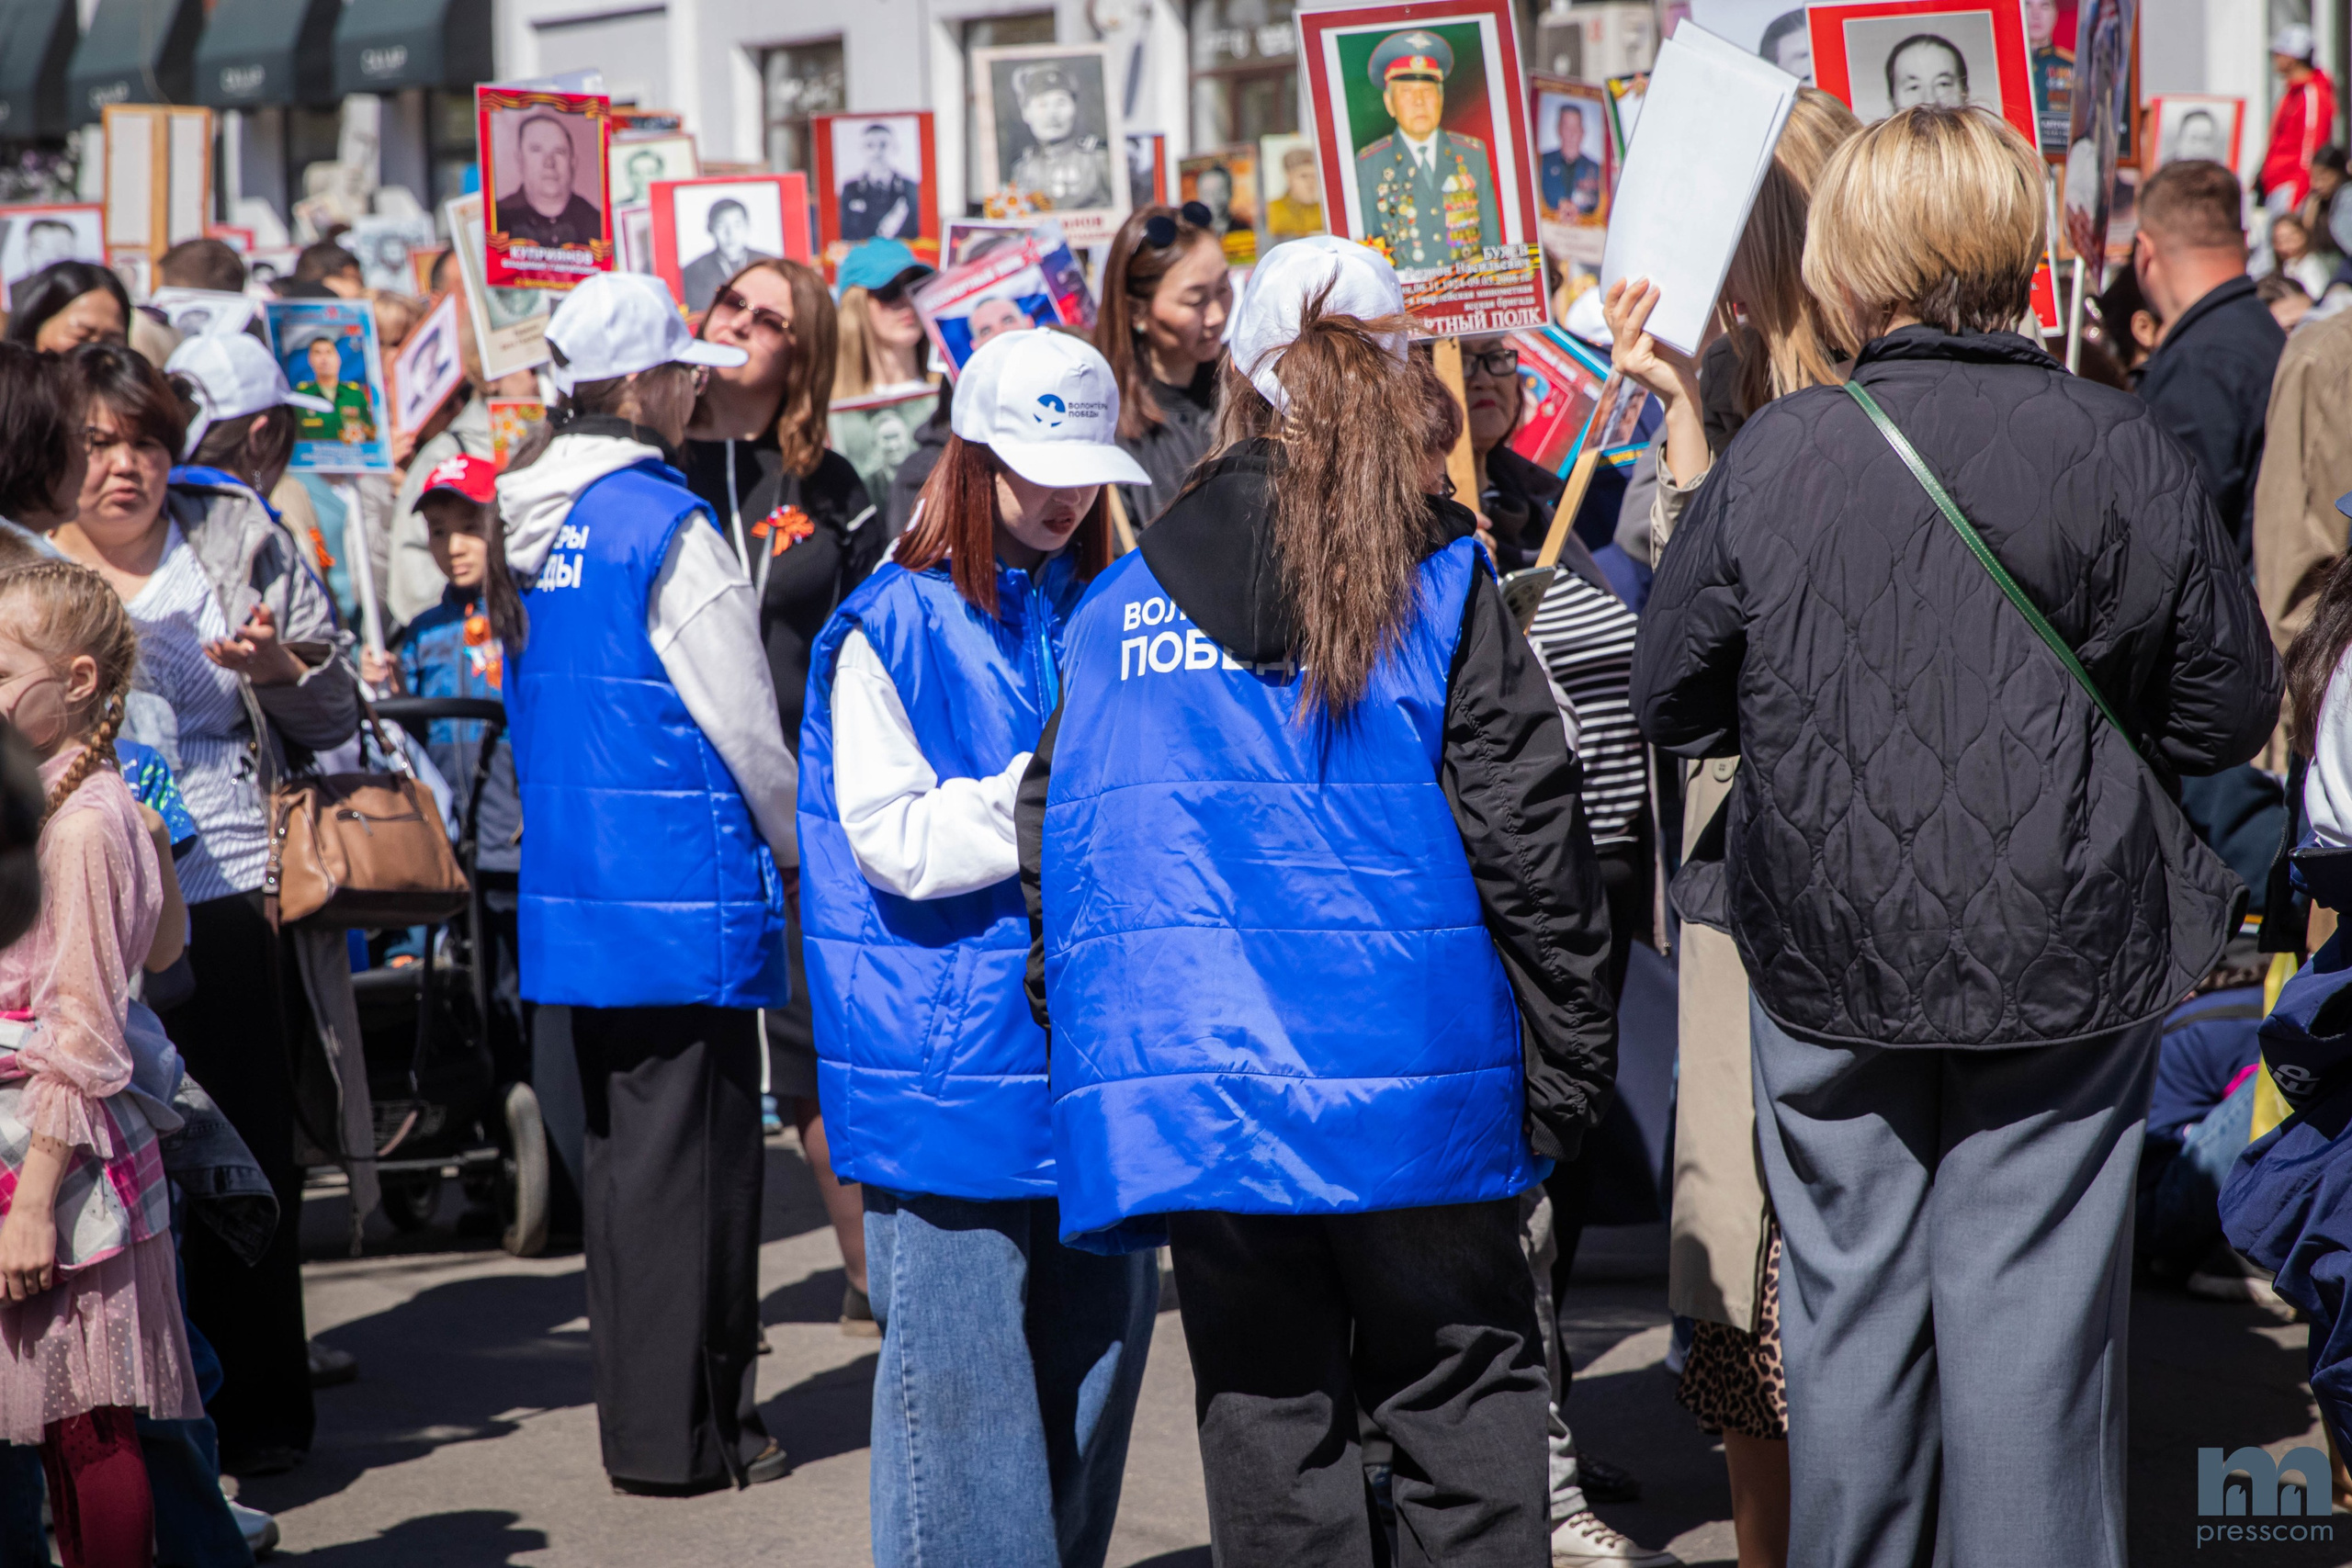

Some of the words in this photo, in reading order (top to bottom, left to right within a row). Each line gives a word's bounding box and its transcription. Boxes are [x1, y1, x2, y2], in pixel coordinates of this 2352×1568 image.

[1483, 244, 1529, 261] БУЯЕВ
[1455, 257, 1531, 275] Васильевич
[1497, 295, 1535, 309] бригада
[1490, 306, 1542, 330] ПОЛК
[536, 554, 583, 592] ДЫ
[1124, 597, 1187, 631] ВОЛ
